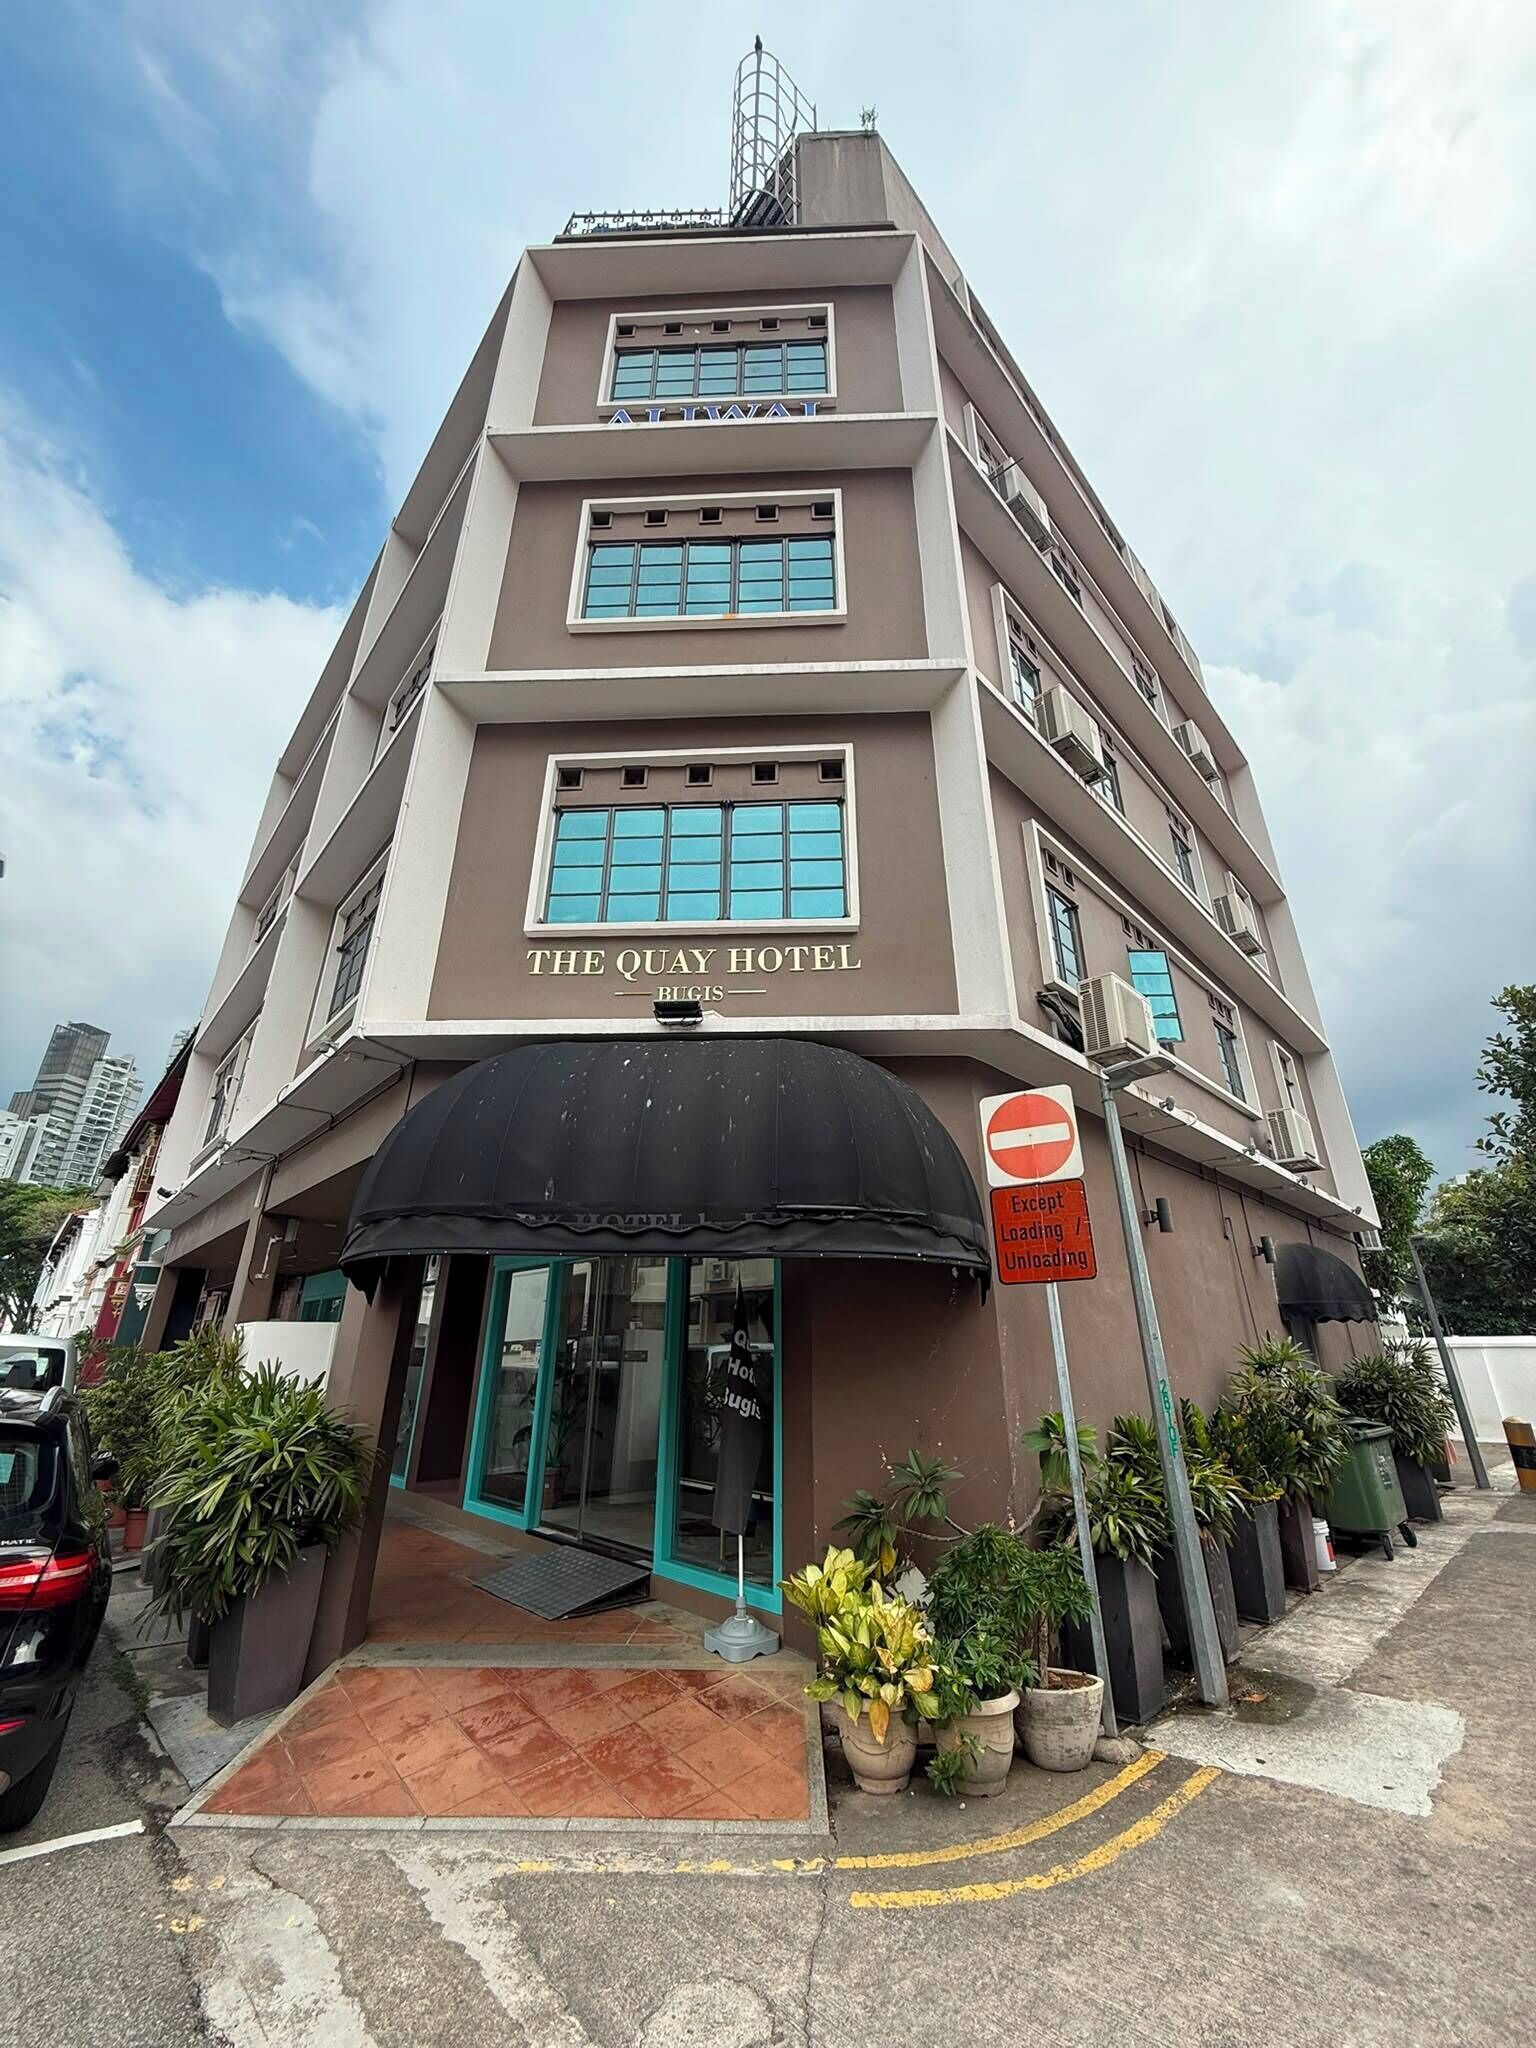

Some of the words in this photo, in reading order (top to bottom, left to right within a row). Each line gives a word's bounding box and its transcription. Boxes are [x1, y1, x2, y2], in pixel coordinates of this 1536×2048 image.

[526, 949, 605, 976] THE
[615, 948, 717, 982] QUAY
[727, 944, 862, 974] HOTEL
[656, 985, 724, 1002] BUGIS
[1011, 1190, 1065, 1215] Except
[1001, 1221, 1064, 1242] Loading
[1004, 1248, 1088, 1271] Unloading
